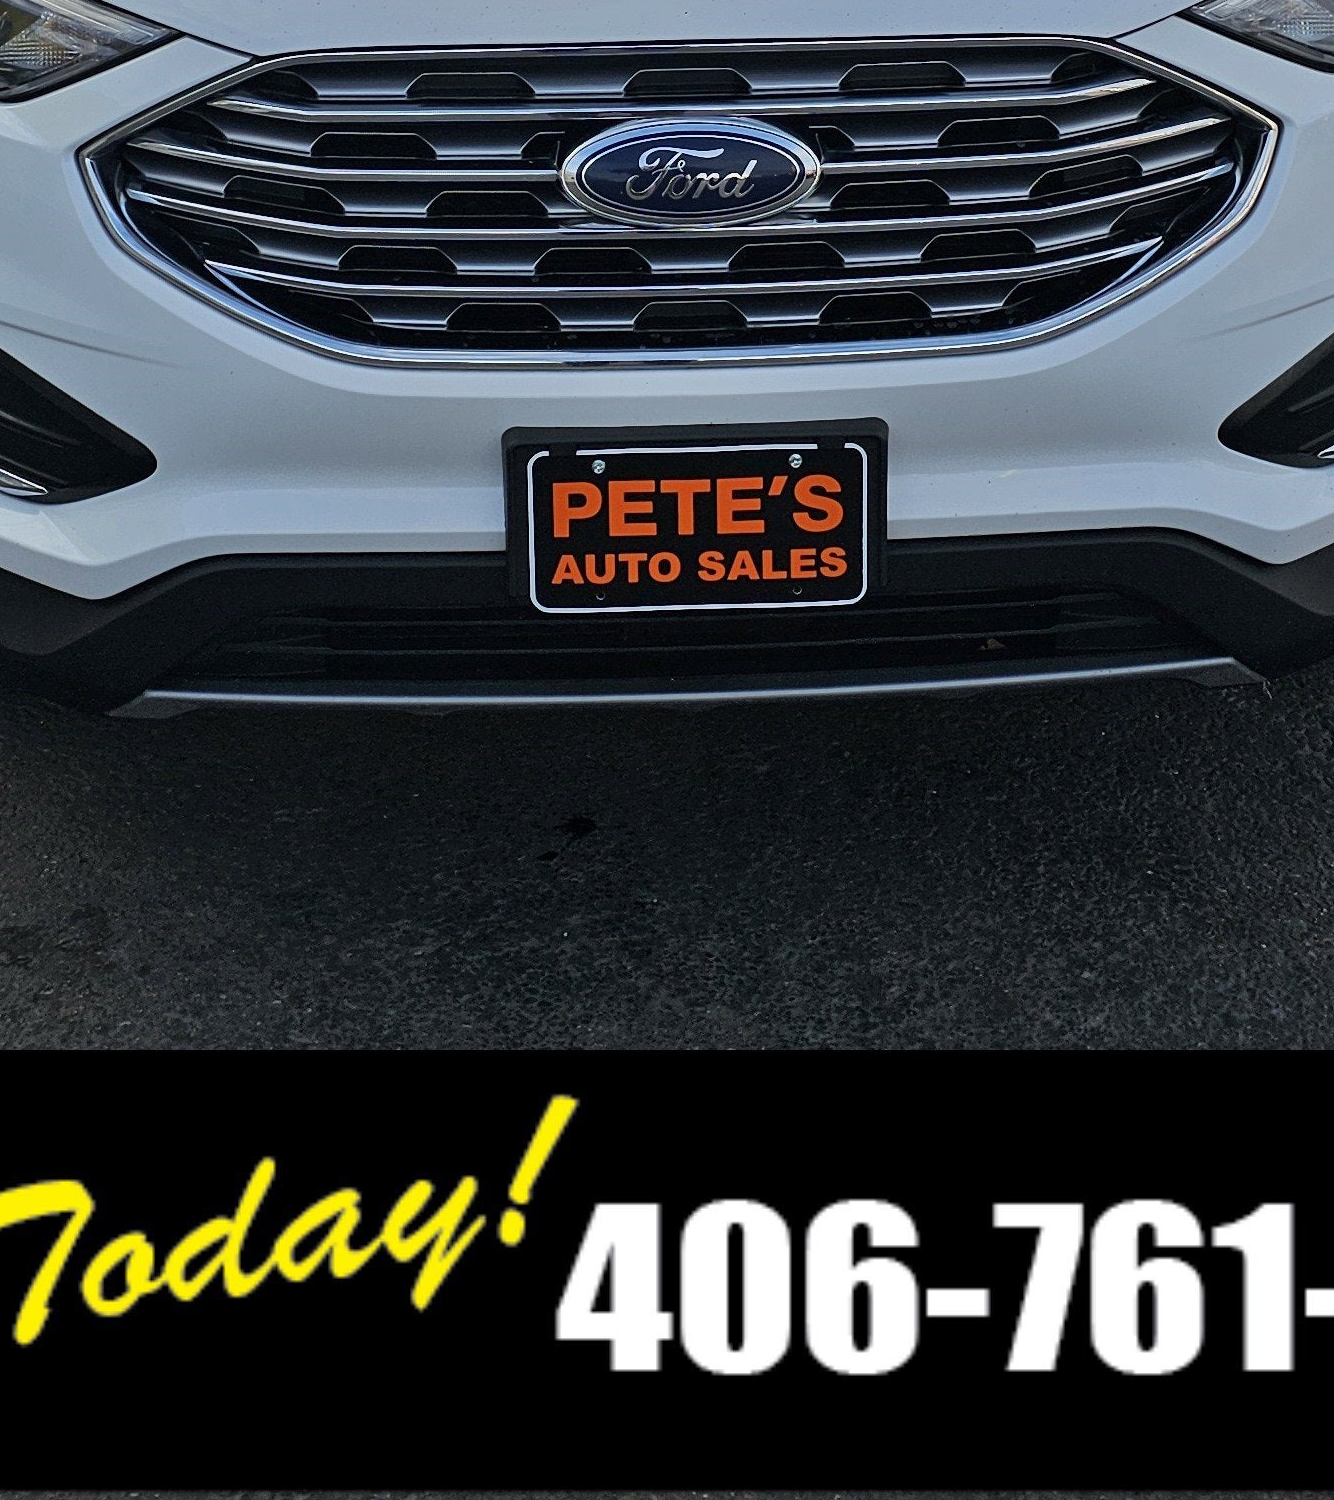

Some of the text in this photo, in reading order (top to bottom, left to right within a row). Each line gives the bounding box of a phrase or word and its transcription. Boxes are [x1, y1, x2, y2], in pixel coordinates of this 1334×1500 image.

[625, 146, 758, 200] Ford
[552, 474, 844, 539] PETE'S
[551, 547, 848, 585] AUTO SALES
